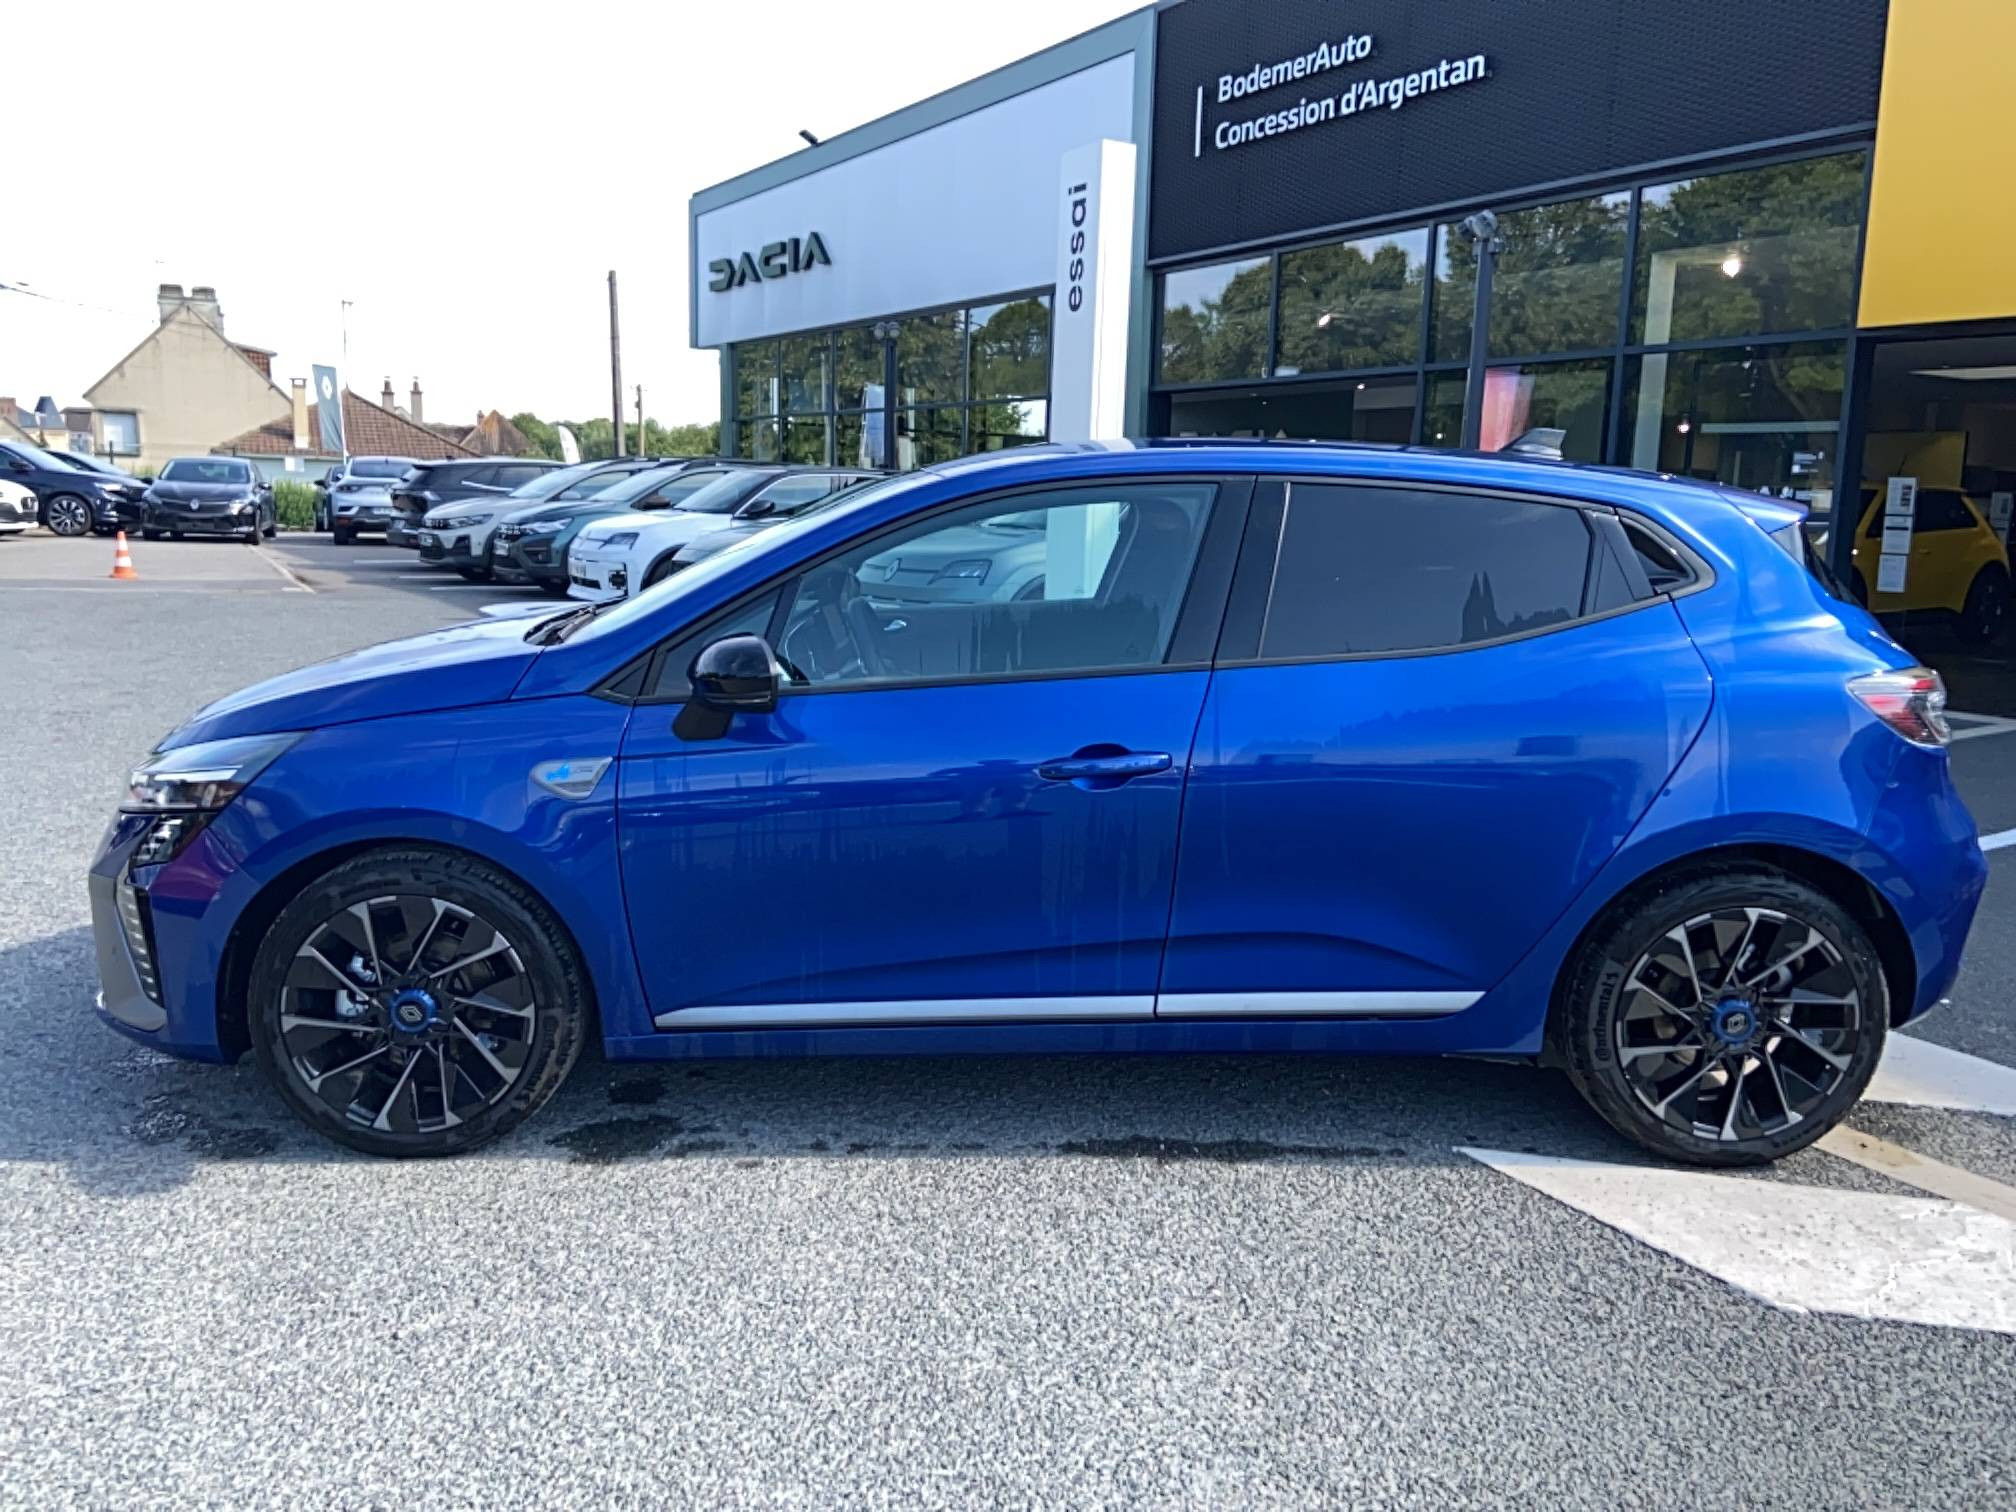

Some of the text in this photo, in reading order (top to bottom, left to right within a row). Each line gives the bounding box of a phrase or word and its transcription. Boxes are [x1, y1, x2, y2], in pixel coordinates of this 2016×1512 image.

[1214, 54, 1487, 149] Concession d'Argentan
[1217, 34, 1373, 103] BodemerAuto
[708, 231, 832, 293] DACIA
[1068, 183, 1087, 313] essai
